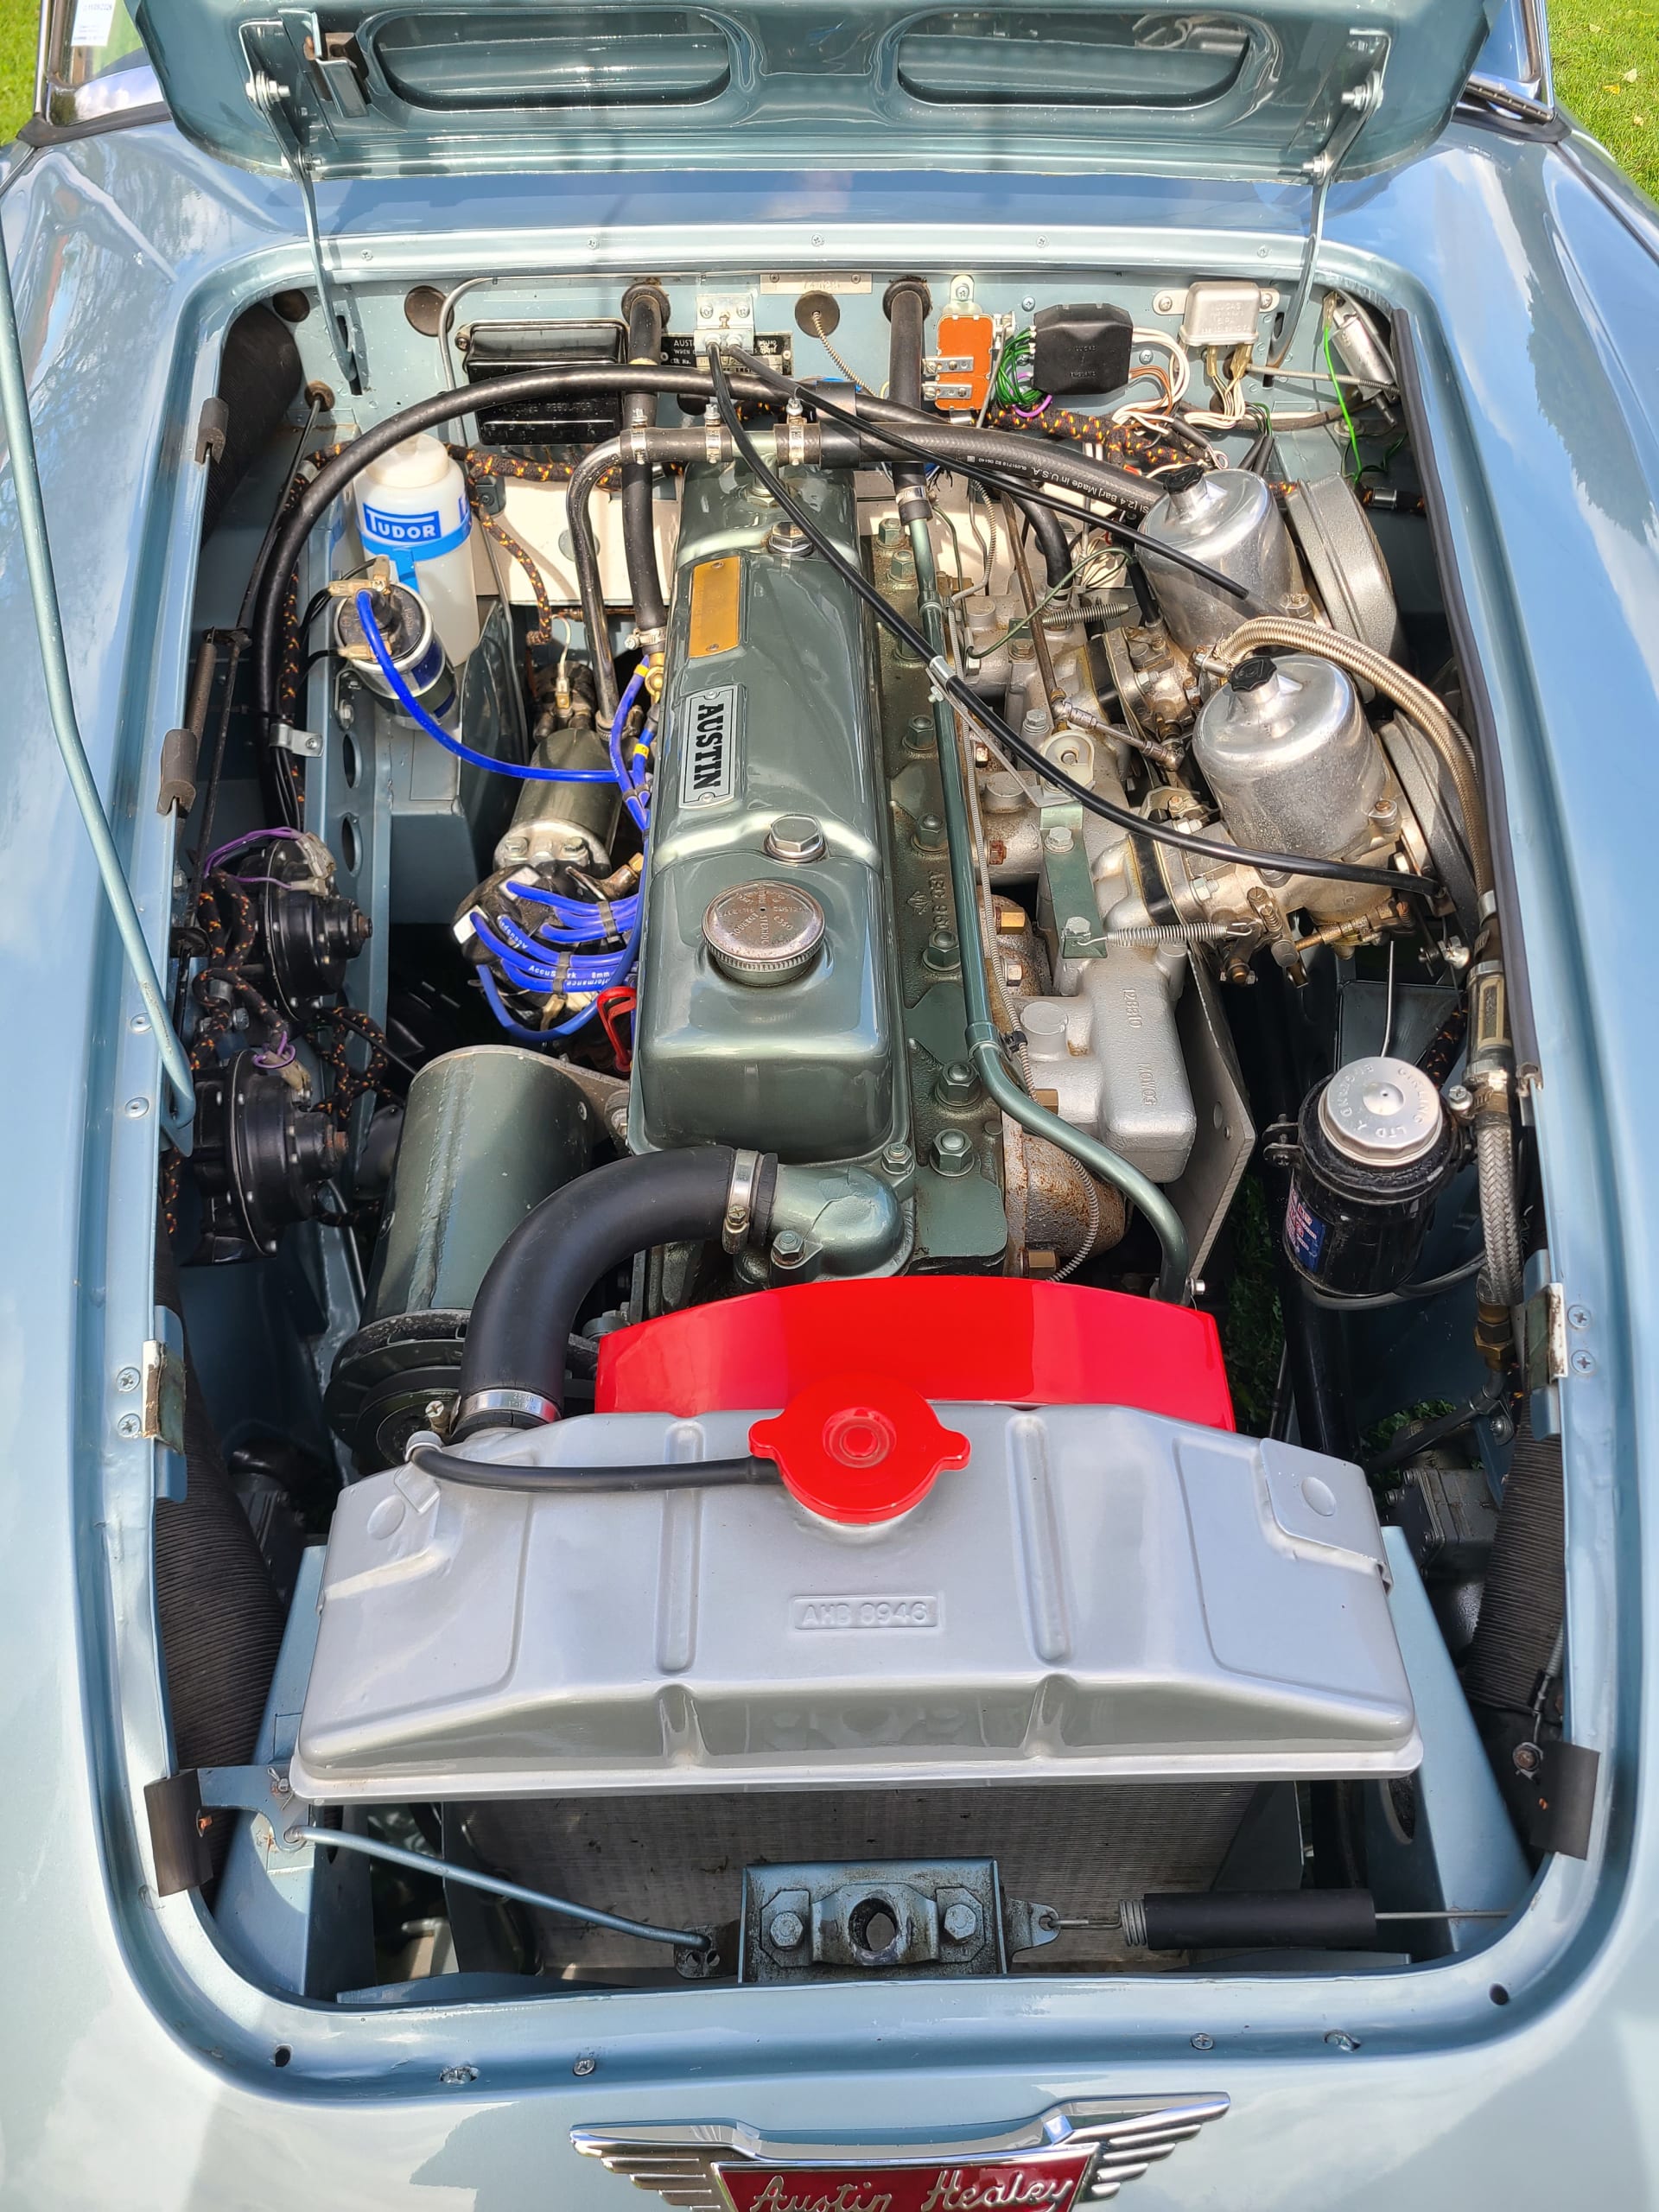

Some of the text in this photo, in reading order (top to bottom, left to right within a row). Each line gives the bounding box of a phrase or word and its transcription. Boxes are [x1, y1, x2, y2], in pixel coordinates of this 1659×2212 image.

[1031, 467, 1058, 482] U.S.A.
[1061, 476, 1070, 485] in
[1072, 480, 1097, 495] Made
[1098, 488, 1117, 504] Bar]
[1140, 505, 1149, 514] SI
[365, 508, 436, 539] TUDOR
[694, 703, 724, 790] AUSTIN
[528, 964, 577, 979] AccuSrk
[1376, 1127, 1407, 1138] LTD
[748, 2169, 1074, 2212] Austin Healey
